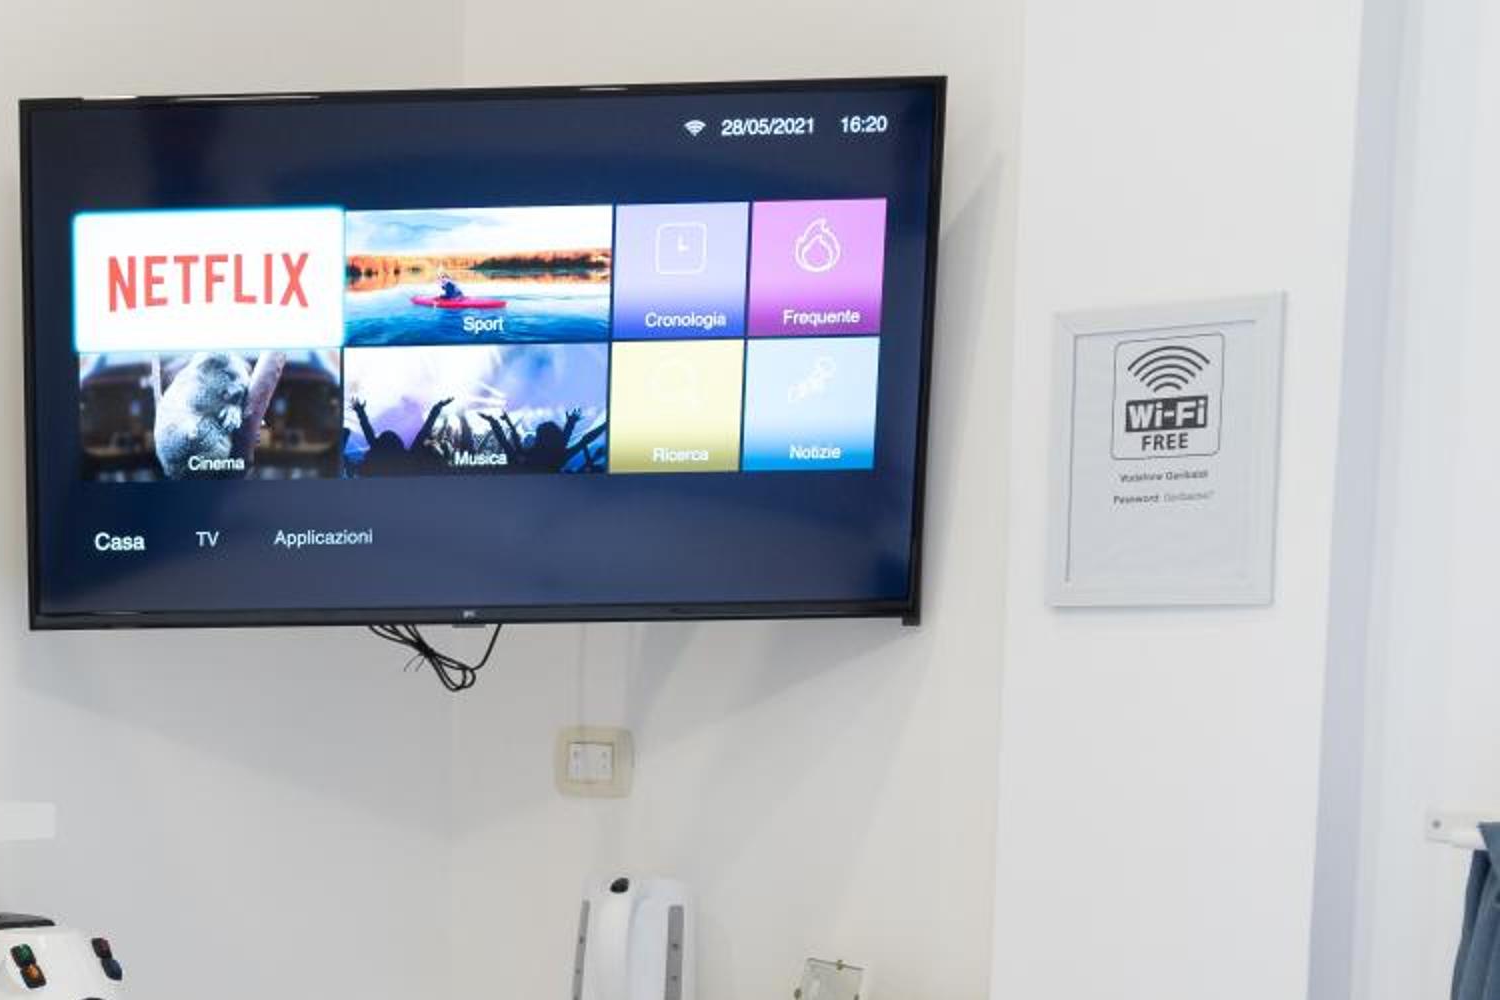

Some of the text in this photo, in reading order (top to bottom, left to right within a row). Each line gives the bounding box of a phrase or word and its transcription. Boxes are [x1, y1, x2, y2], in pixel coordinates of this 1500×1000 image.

[721, 115, 888, 137] 28/05/2021 16:20
[107, 252, 310, 313] NETFLIX
[463, 316, 505, 334] Sport
[644, 311, 727, 330] Cronologia
[783, 309, 861, 327] Frequente
[1127, 399, 1206, 429] Wi-Fi
[1141, 432, 1189, 451] FREE
[454, 450, 508, 466] Musica
[789, 444, 842, 460] Notizie
[187, 455, 245, 472] Cinema
[94, 528, 373, 551] Casa TV Applicazioni
